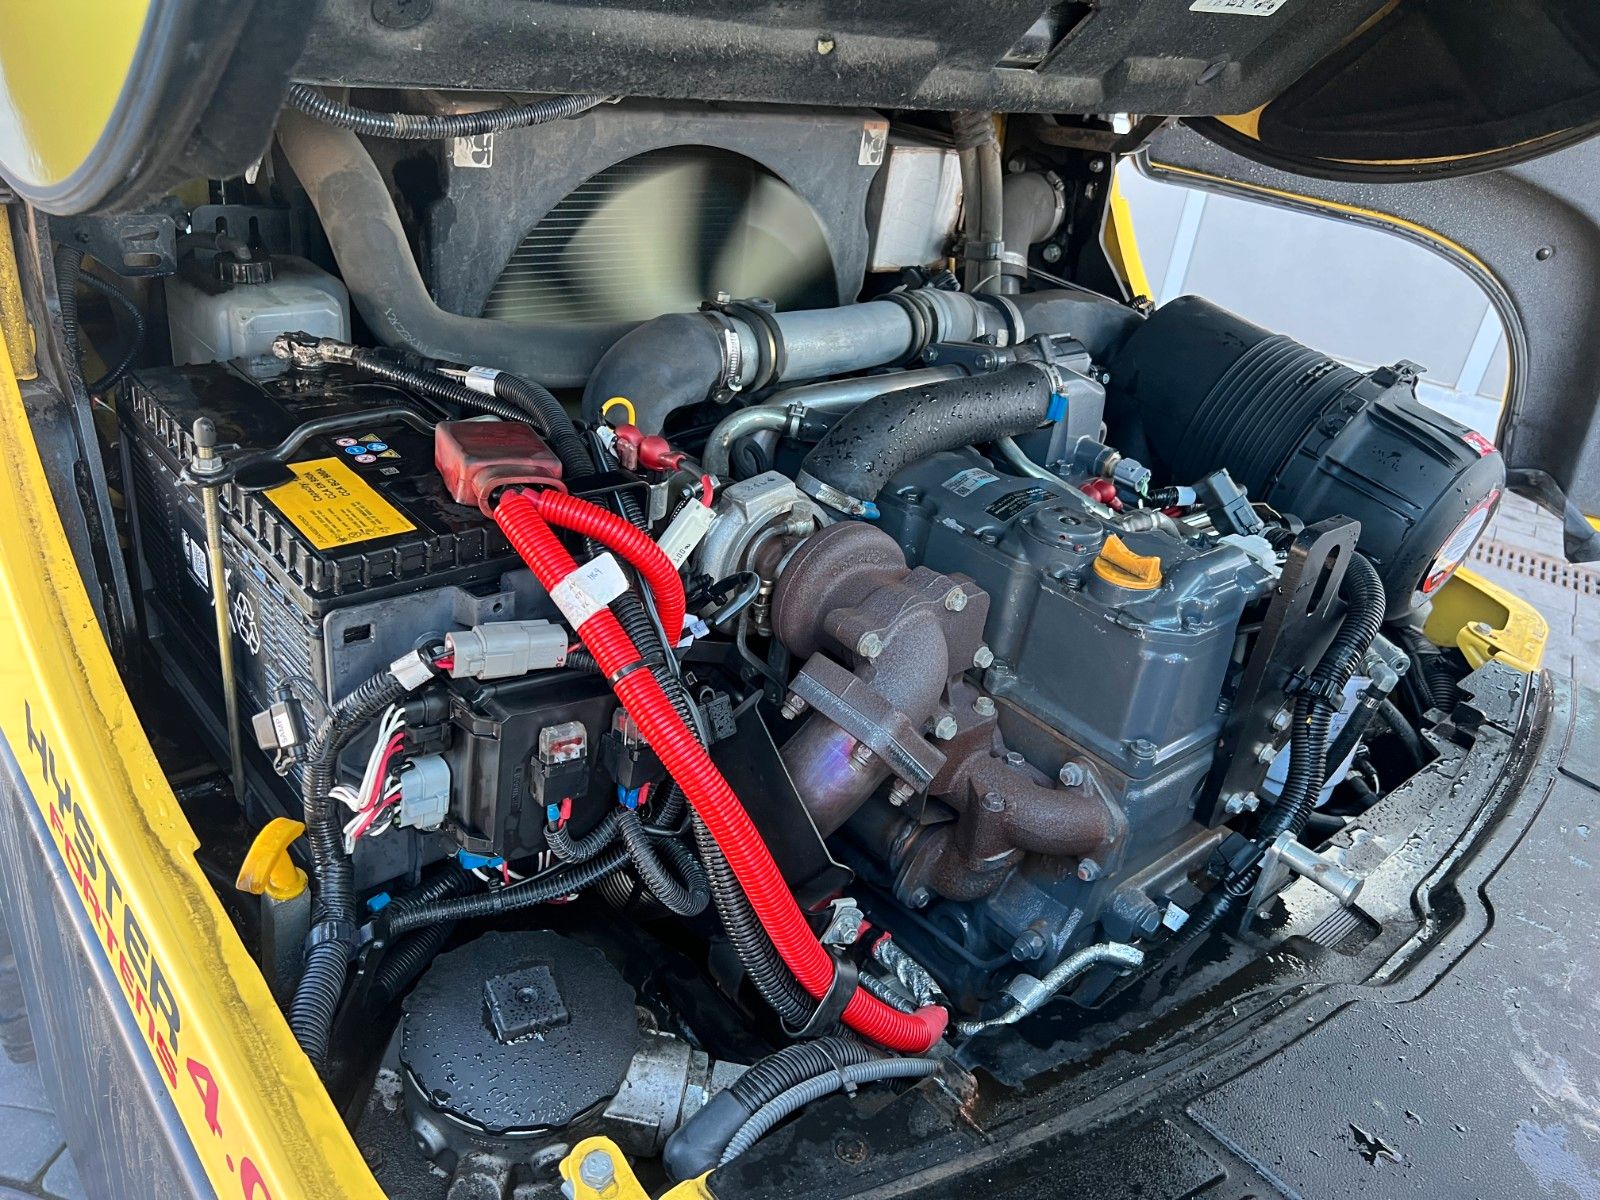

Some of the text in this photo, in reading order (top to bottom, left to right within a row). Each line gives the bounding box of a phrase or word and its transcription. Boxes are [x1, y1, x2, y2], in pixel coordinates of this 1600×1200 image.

[322, 489, 337, 499] CCA
[336, 486, 351, 496] CCA
[25, 699, 180, 1056] HYSTER
